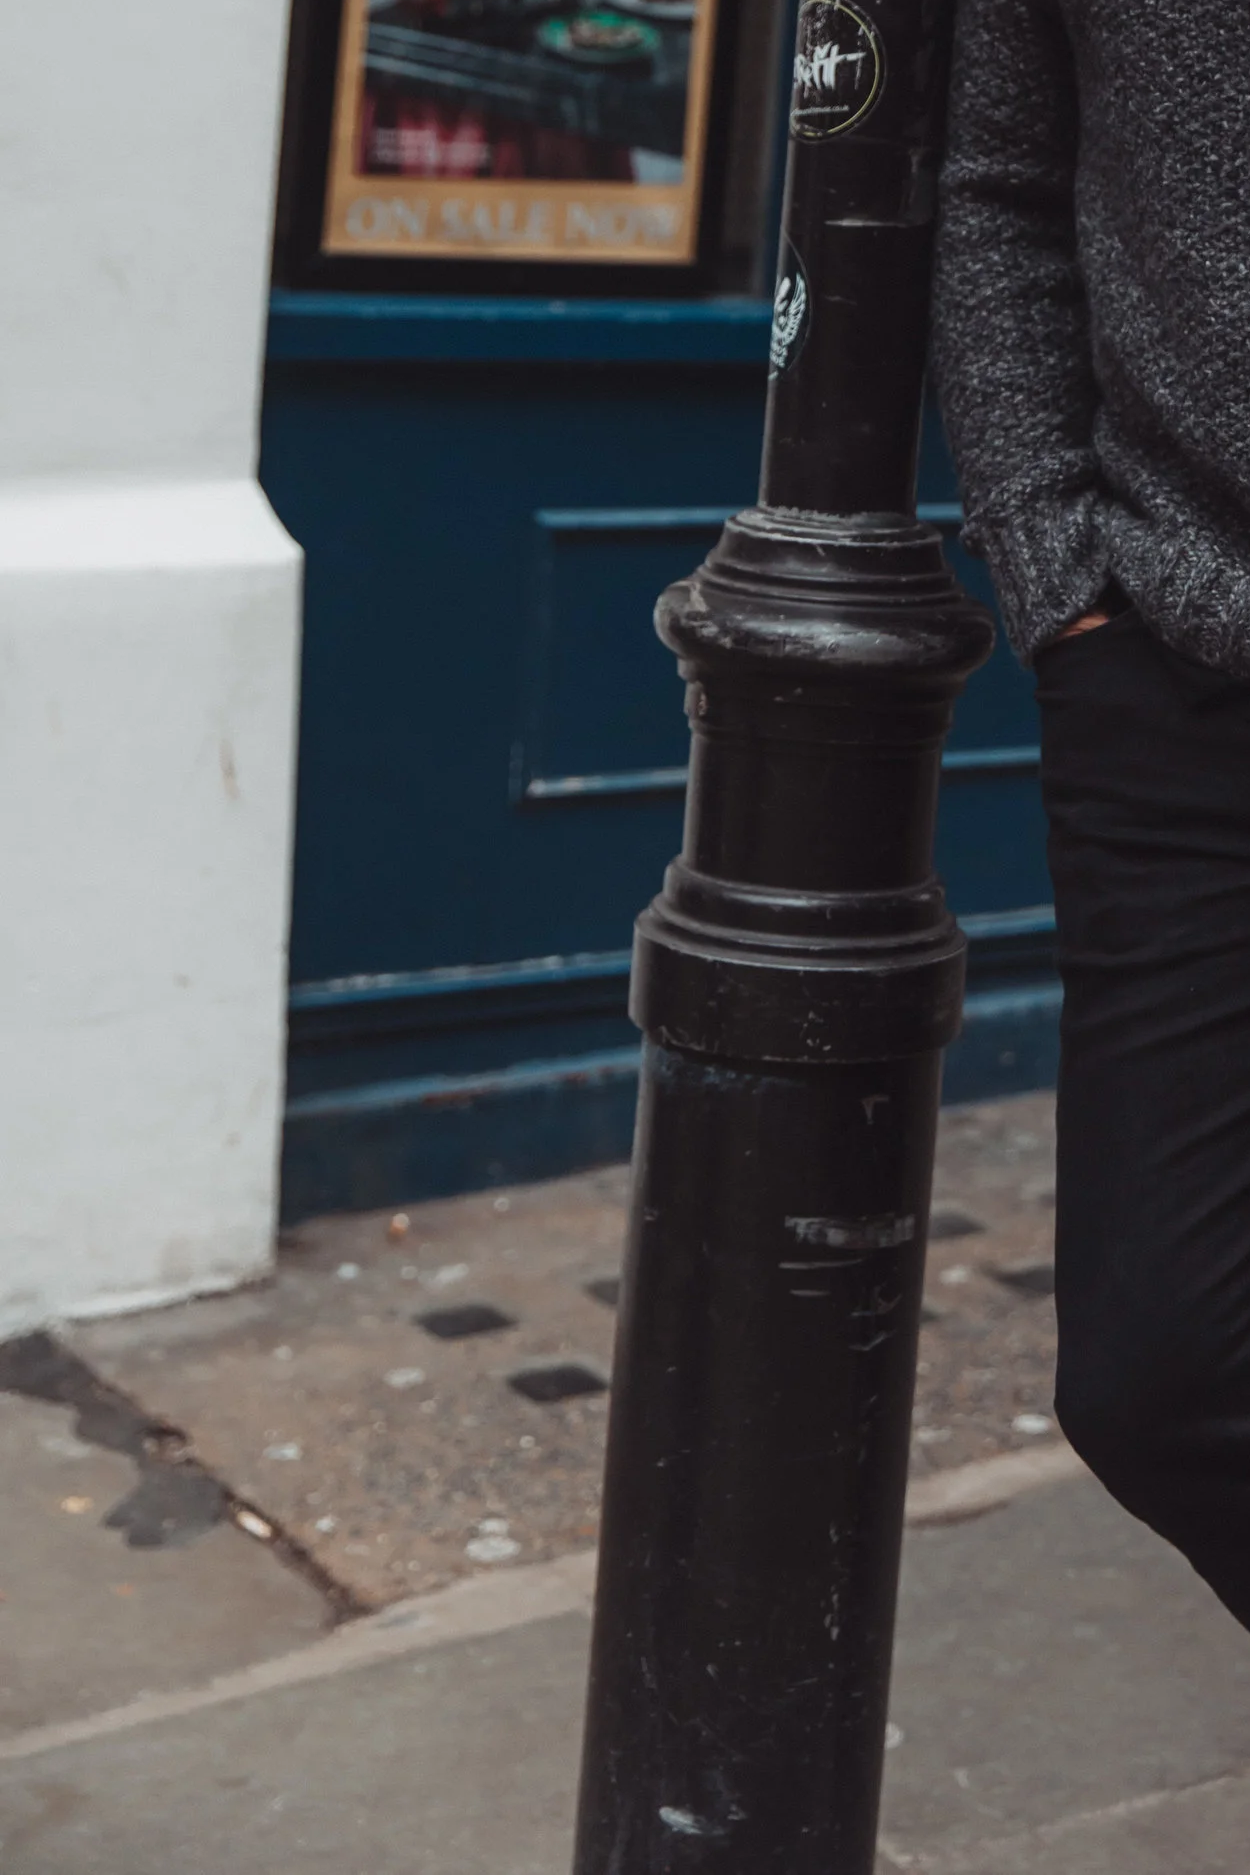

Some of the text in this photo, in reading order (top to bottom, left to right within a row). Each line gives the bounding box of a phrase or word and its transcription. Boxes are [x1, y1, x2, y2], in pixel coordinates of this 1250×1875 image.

[345, 195, 678, 247] ON SALE NOW
